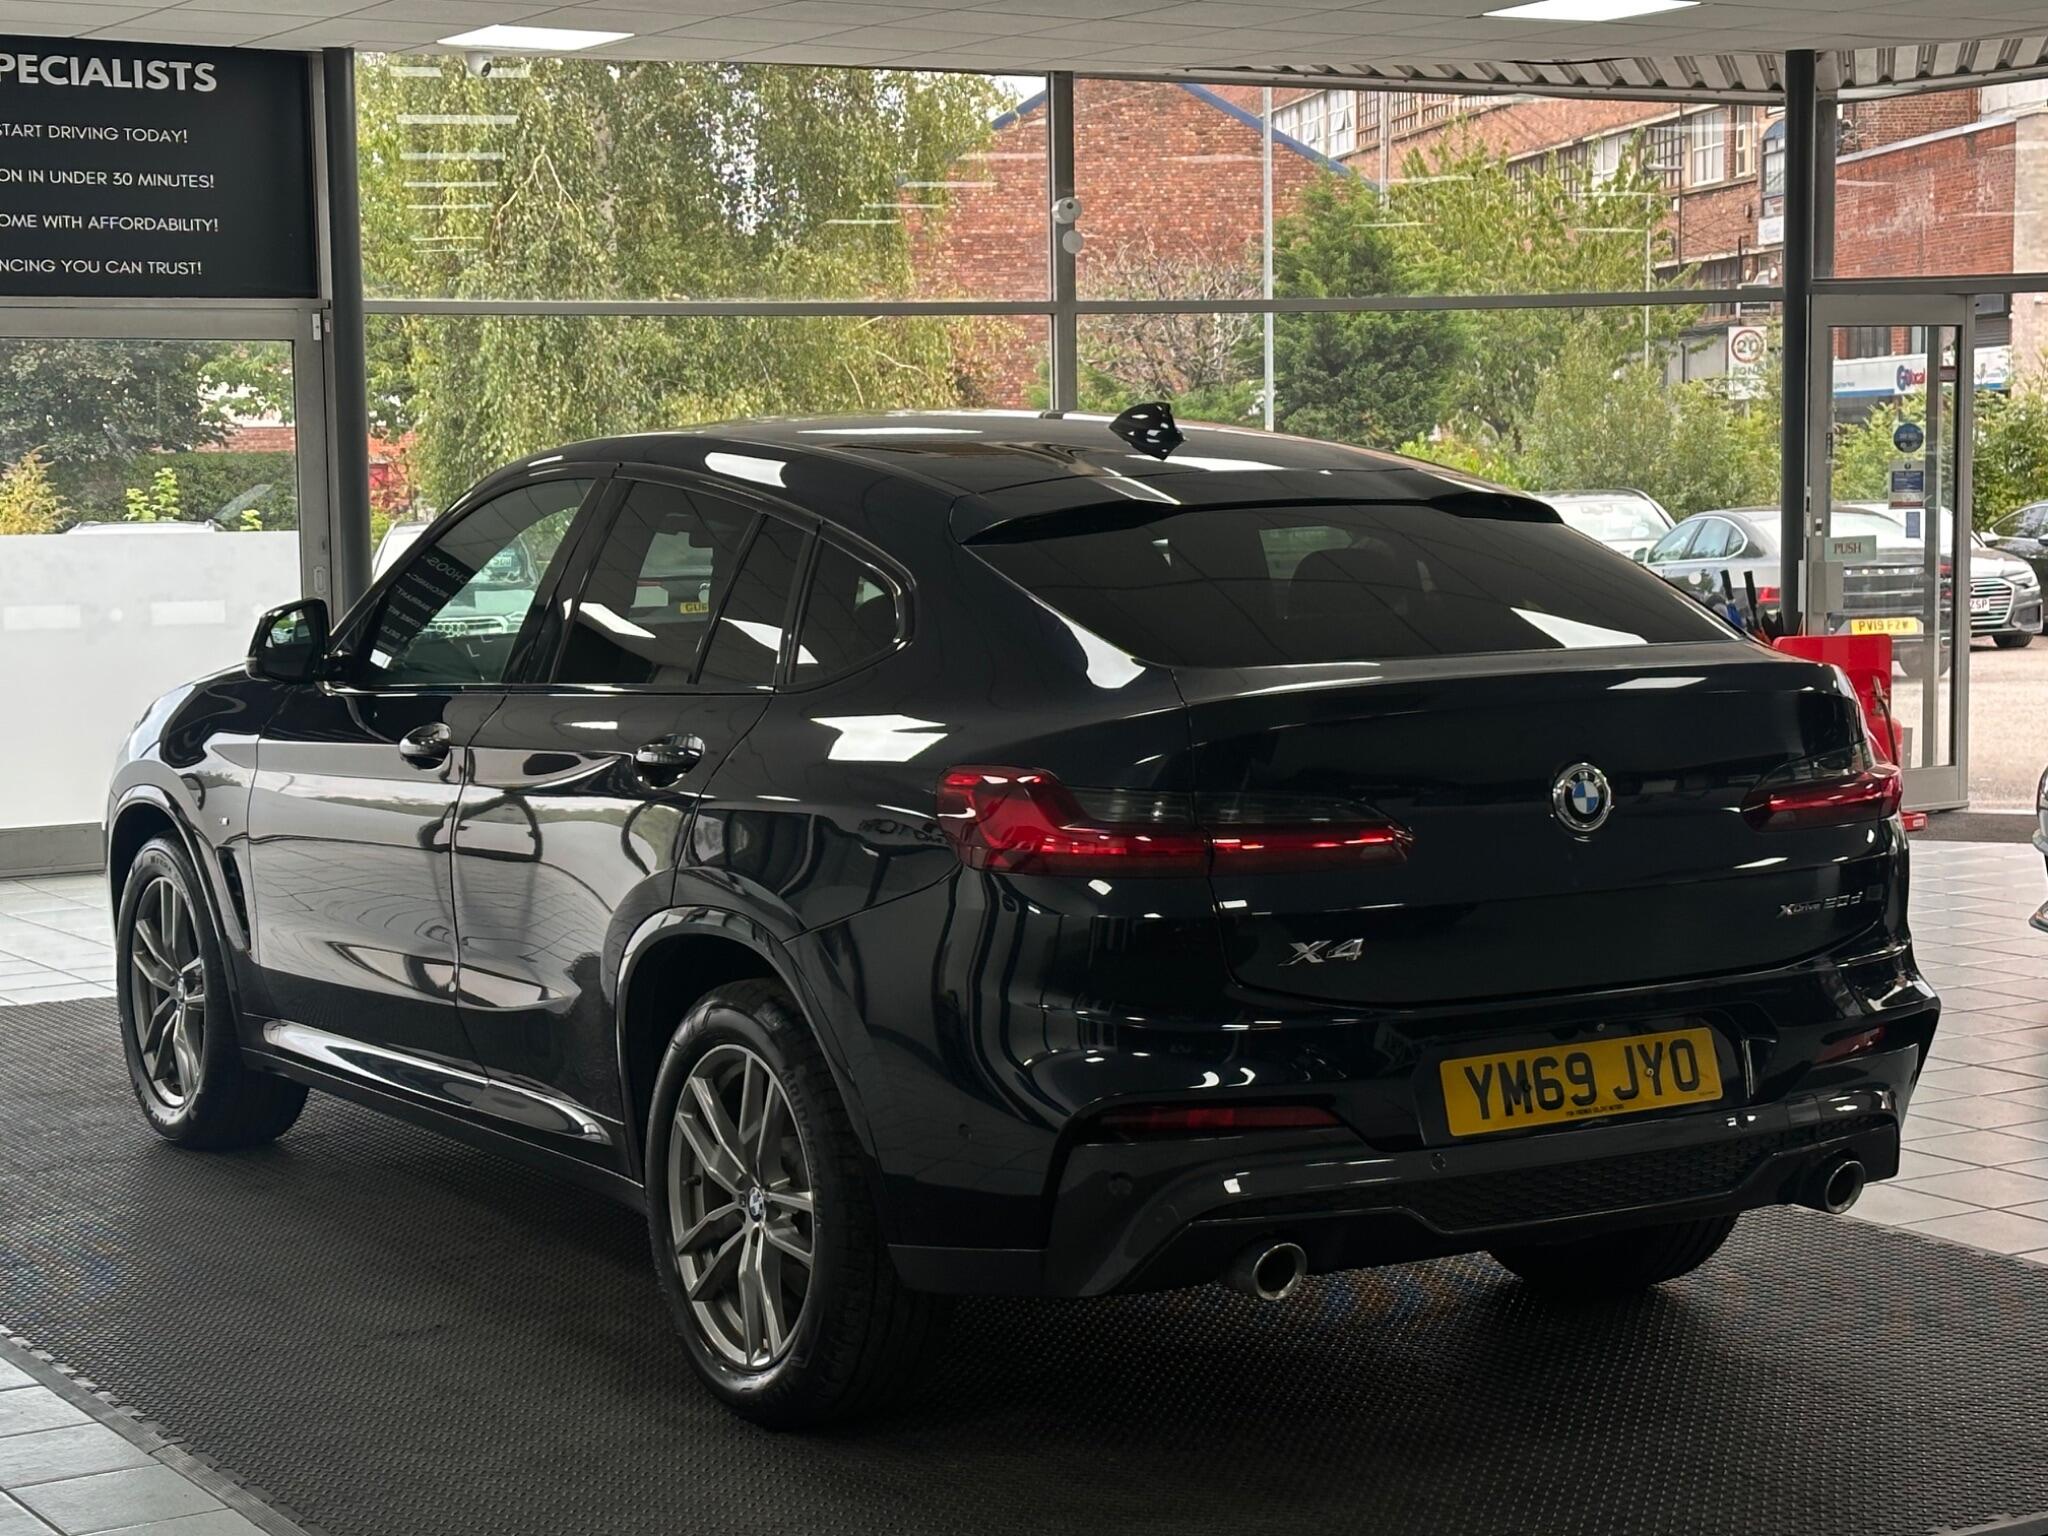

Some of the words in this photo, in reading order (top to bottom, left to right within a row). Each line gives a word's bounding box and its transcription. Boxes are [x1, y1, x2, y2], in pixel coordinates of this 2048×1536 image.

[0, 53, 217, 92] PECIALISTS
[48, 125, 119, 141] DRIVING
[123, 127, 188, 144] TODAY!
[0, 168, 22, 183] ON
[28, 170, 44, 183] IN
[50, 171, 108, 185] UNDER
[112, 172, 133, 186] 30
[138, 173, 215, 189] MINUTES!
[0, 213, 37, 228] OME
[42, 215, 83, 229] WITH
[87, 216, 219, 232] AFFORDABILITY!
[0, 258, 56, 273] NCING
[60, 259, 100, 274] YOU
[105, 260, 143, 274] CAN
[146, 261, 202, 275] TRUST!
[1833, 541, 1862, 555] PUSH
[1278, 938, 1364, 966] X4
[1463, 1052, 1598, 1121] YM69
[1612, 1038, 1700, 1101] JYO
